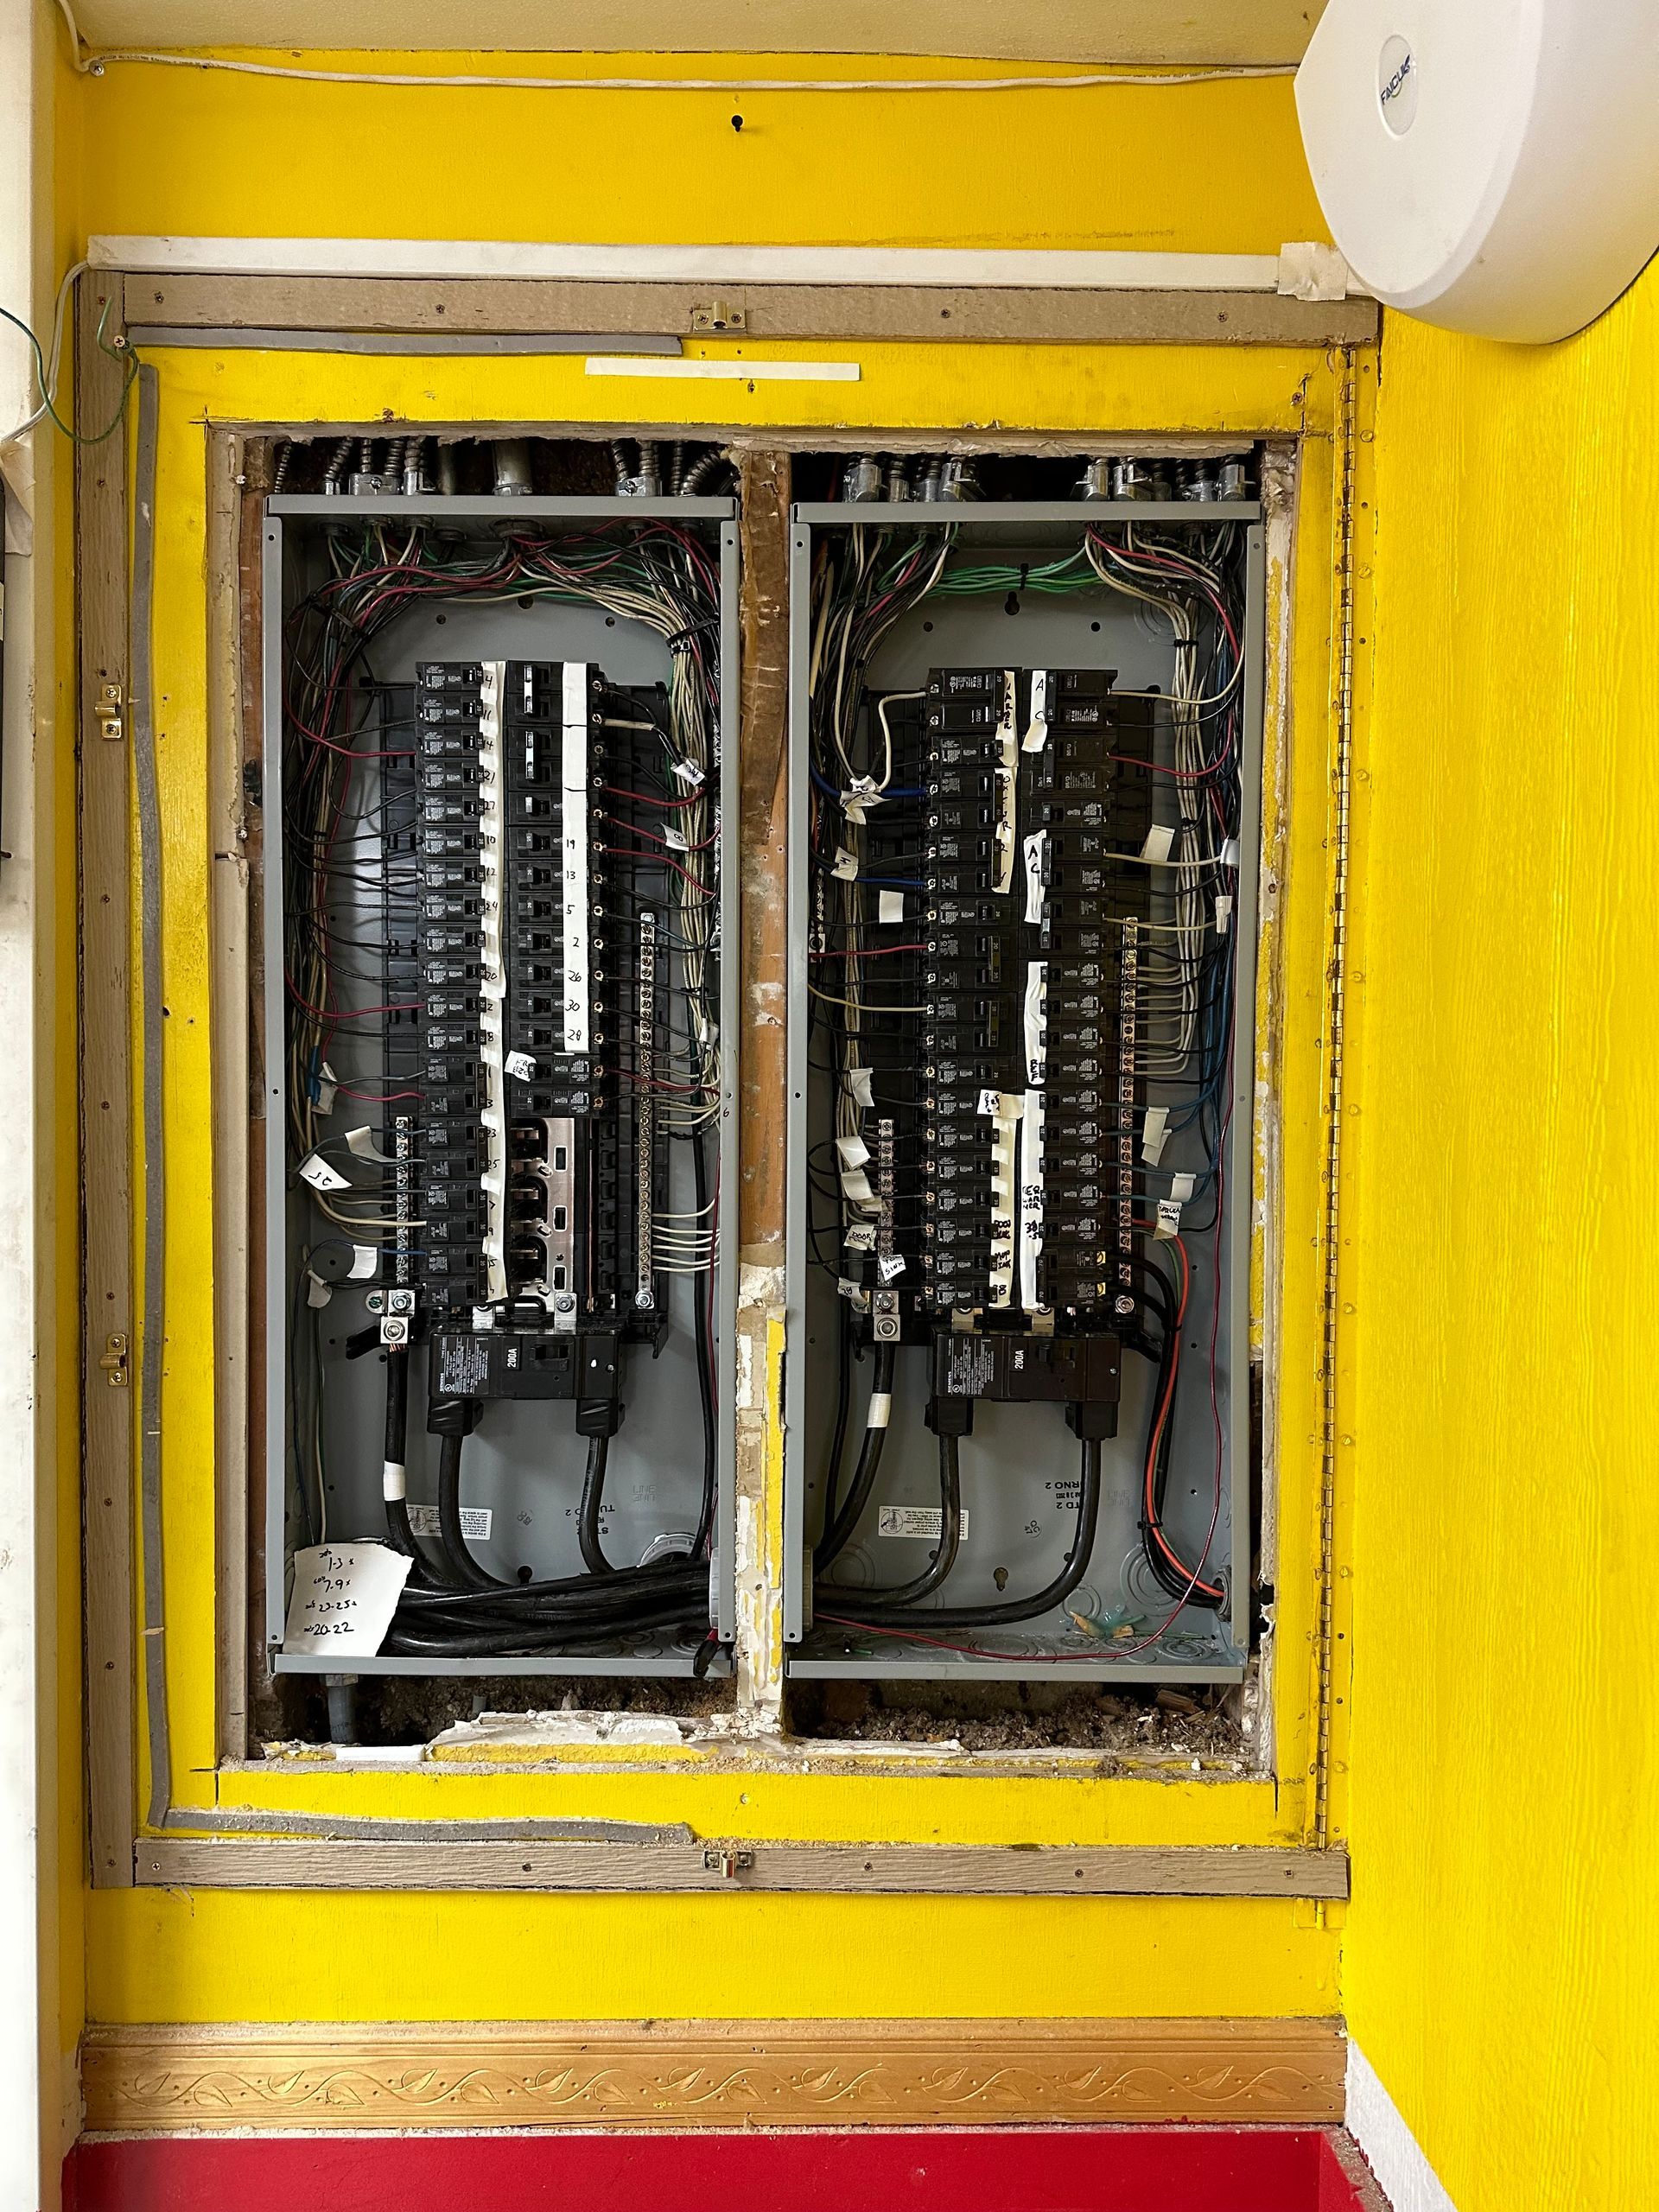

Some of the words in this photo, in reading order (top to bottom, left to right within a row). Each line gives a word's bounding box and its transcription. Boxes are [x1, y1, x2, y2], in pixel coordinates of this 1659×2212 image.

[486, 676, 493, 689] 4
[1036, 678, 1043, 691] A
[484, 801, 495, 810] 27
[486, 836, 496, 844] 10
[566, 839, 575, 849] 19
[486, 868, 497, 876] 12
[566, 870, 575, 880] 13
[486, 900, 498, 912] 24
[566, 905, 575, 914] 5
[573, 937, 580, 948] 2
[568, 970, 582, 982] 26
[565, 999, 580, 1012] 30
[567, 1029, 582, 1041] 28
[506, 1348, 518, 1368] 200A
[1014, 1350, 1024, 1370] 200A
[1054, 1481, 1080, 1490] RNO
[328, 1557, 343, 1572] 1-3
